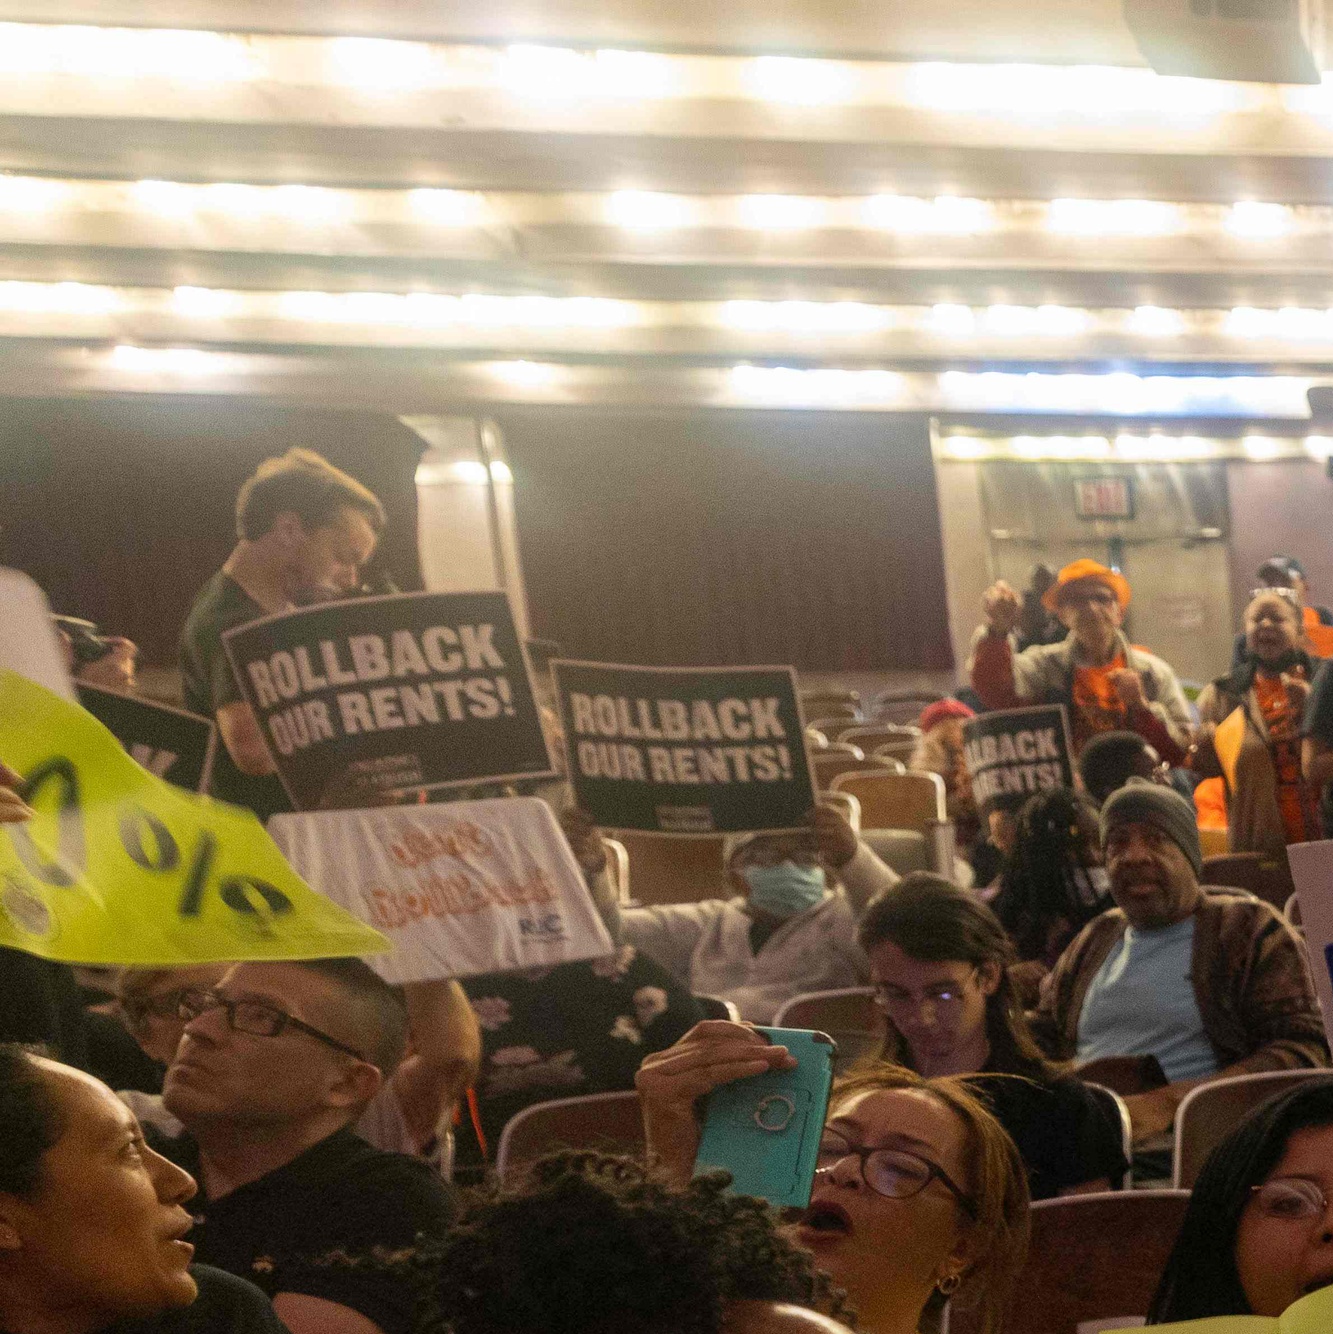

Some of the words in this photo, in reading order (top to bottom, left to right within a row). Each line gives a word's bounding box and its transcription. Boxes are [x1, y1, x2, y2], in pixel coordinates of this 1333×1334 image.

[247, 622, 505, 709] ROLLBACK
[268, 701, 335, 757] OUR
[336, 674, 517, 734] RENTS!
[569, 690, 787, 740] ROLLBACK
[577, 740, 647, 781] OUR
[648, 743, 794, 784] RENTS!
